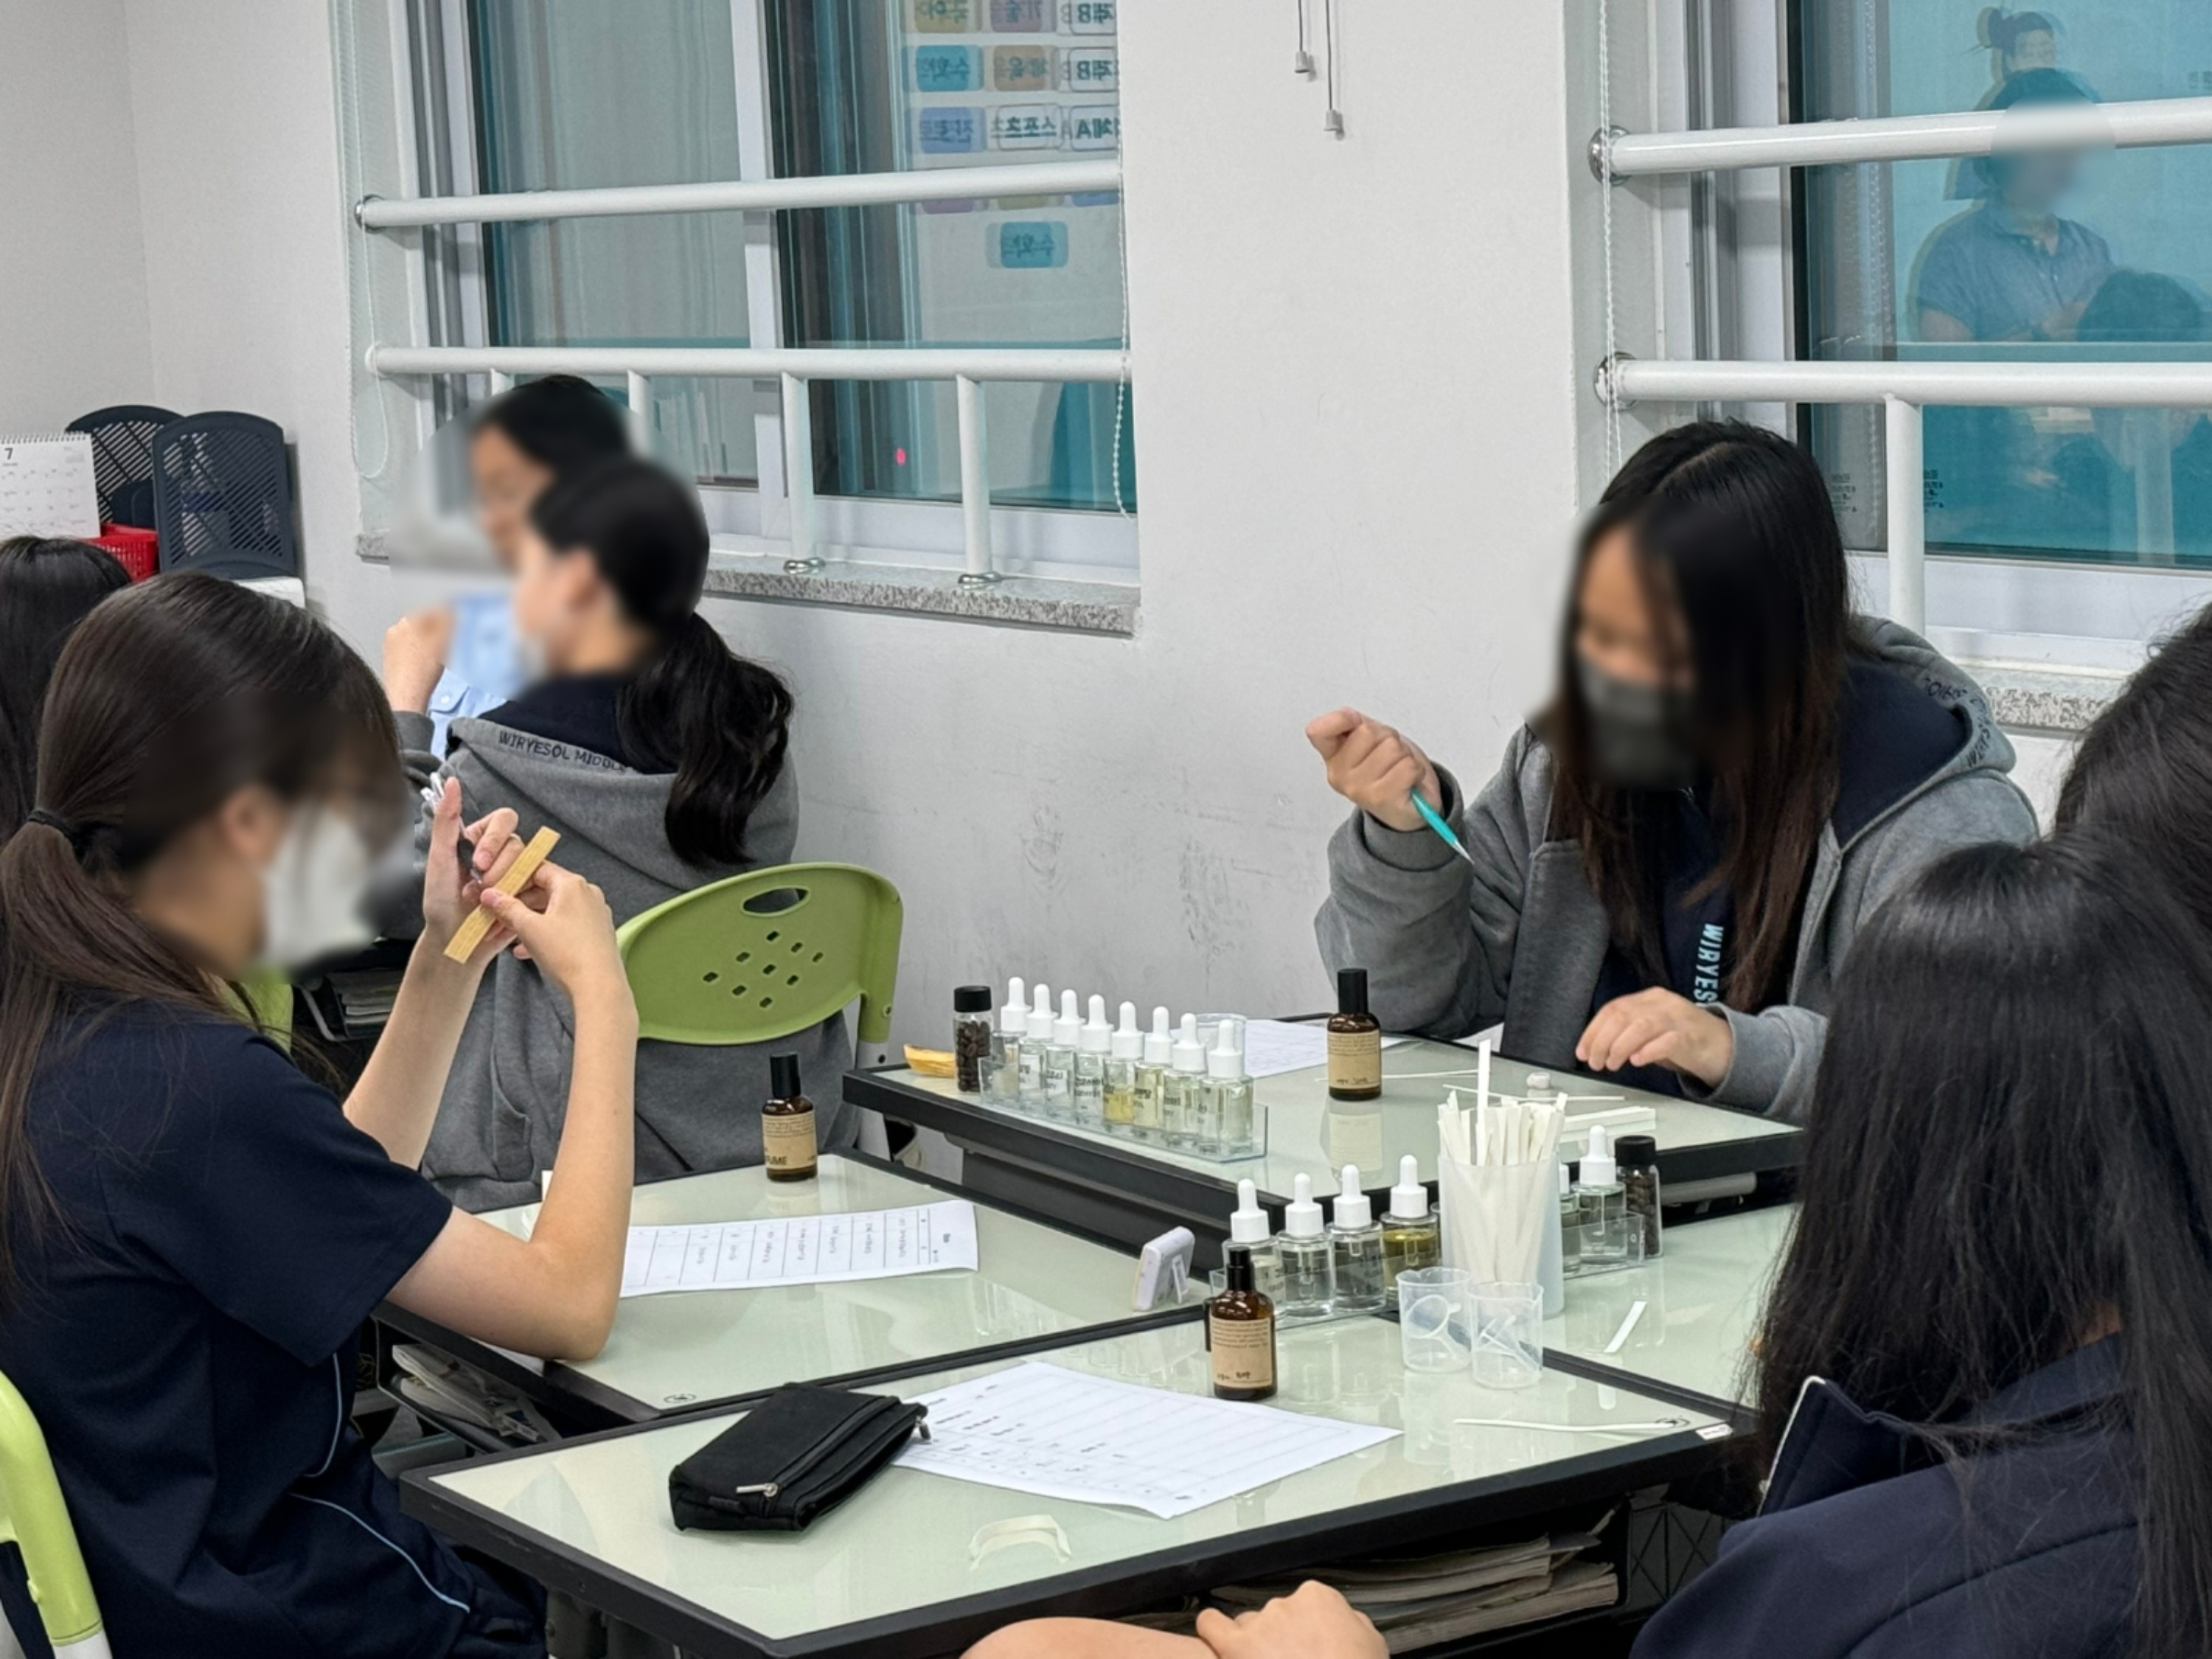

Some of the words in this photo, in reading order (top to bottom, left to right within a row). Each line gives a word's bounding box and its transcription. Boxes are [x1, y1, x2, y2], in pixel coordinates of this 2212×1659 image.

[4, 447, 13, 460] 7
[498, 731, 570, 759] WIRYESOL
[1693, 922, 1725, 1004] WIRYES
